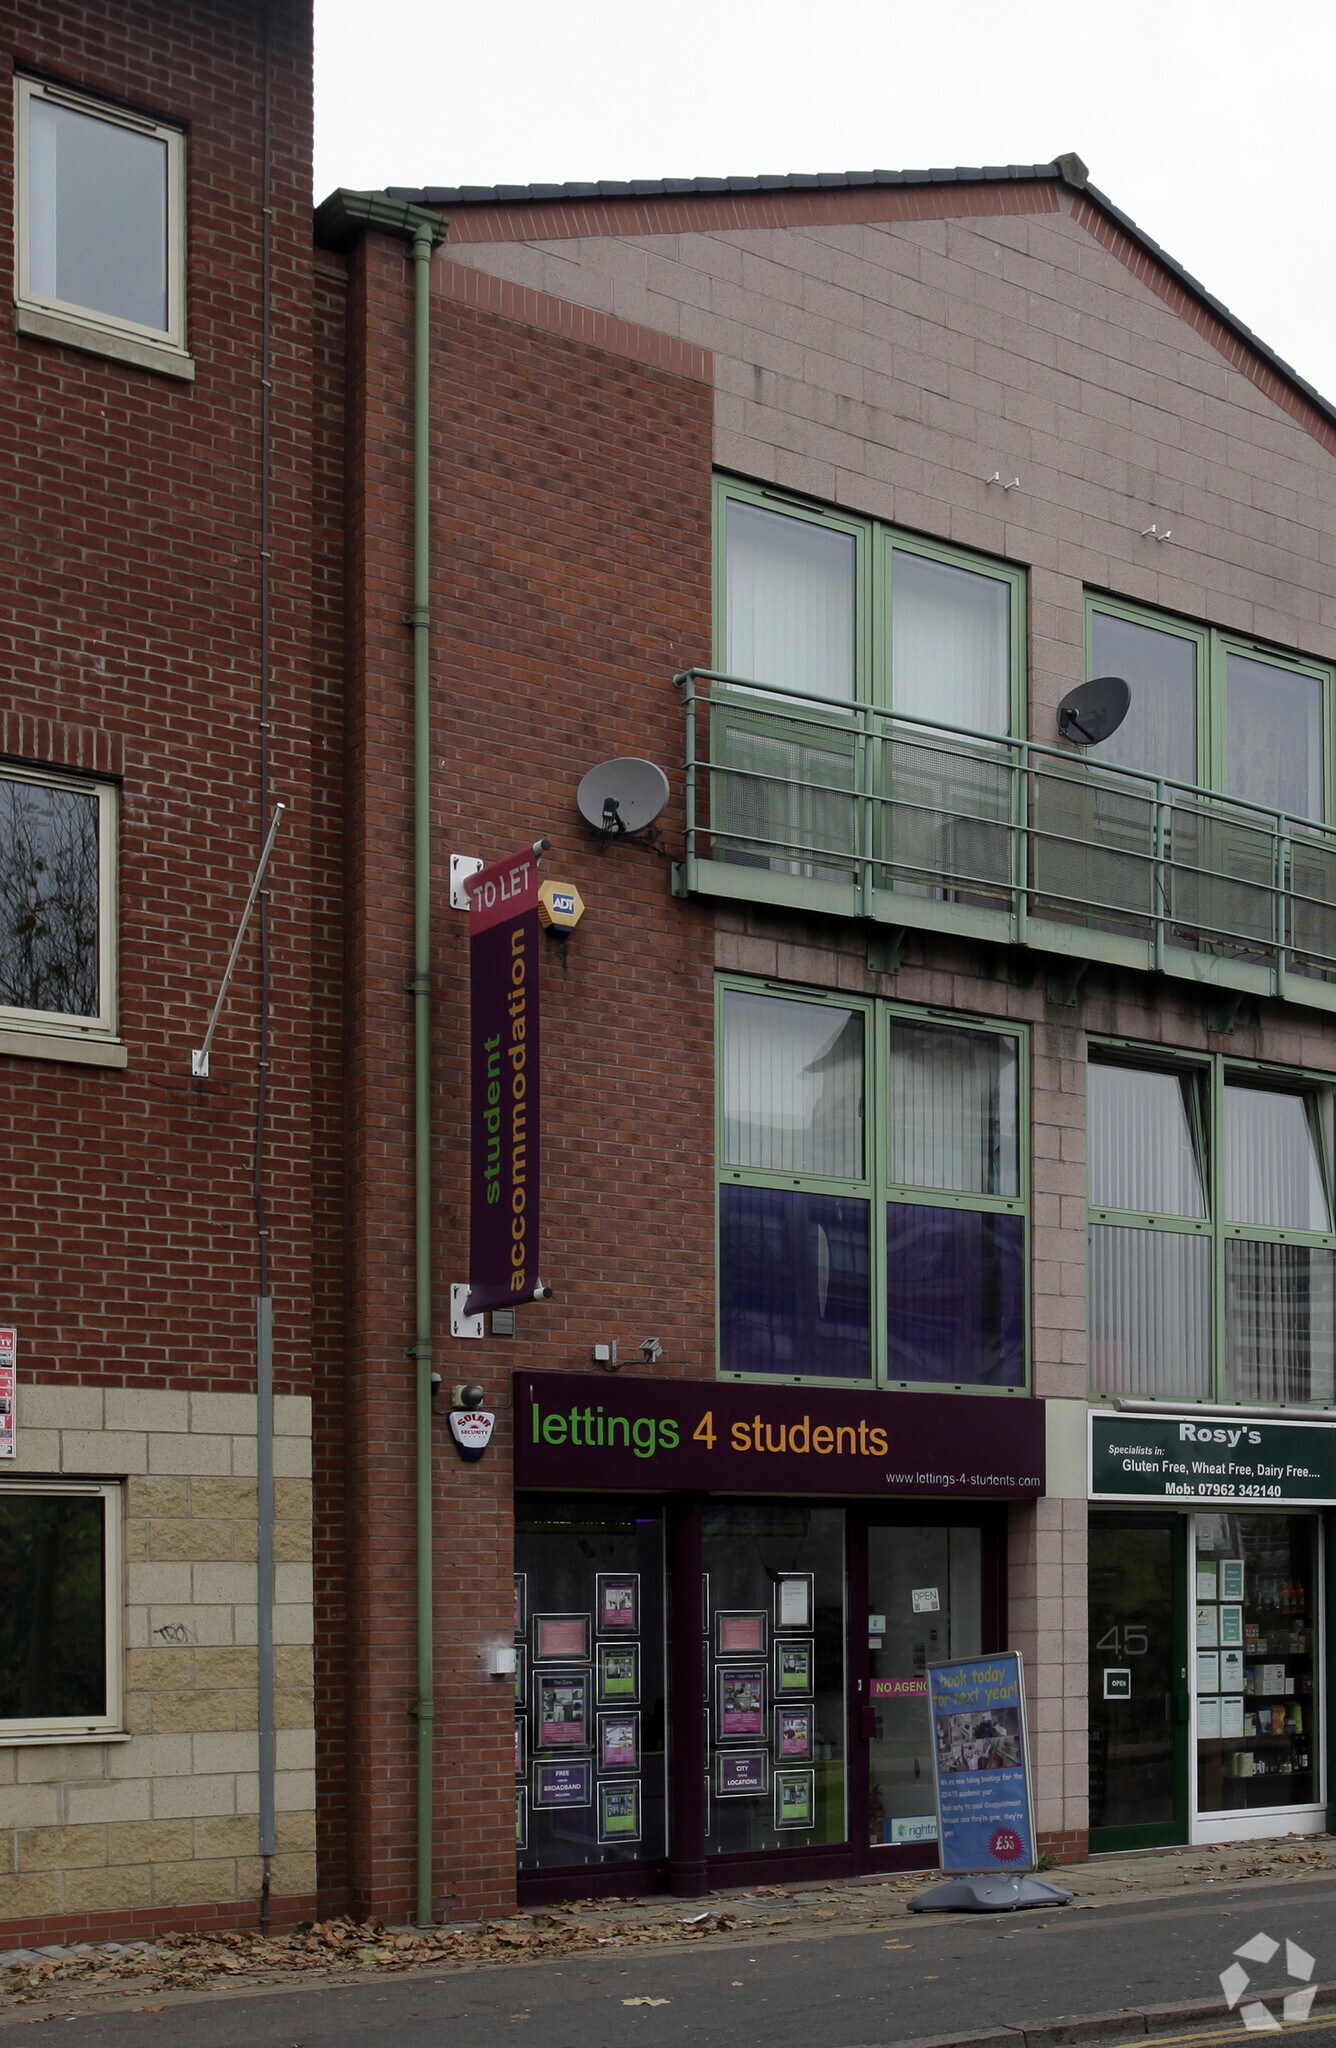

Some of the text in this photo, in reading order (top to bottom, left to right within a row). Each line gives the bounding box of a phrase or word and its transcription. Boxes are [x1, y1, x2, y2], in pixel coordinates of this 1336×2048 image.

[473, 862, 530, 912] TO LET
[553, 897, 574, 910] ADT
[484, 1033, 501, 1205] student
[508, 928, 527, 1292] accommodation
[457, 1414, 491, 1427] SOLAR
[532, 1403, 889, 1459] lettings 4 students
[1179, 1423, 1262, 1448] Rosy's
[1108, 1444, 1166, 1456] Specialists in:
[1122, 1459, 1320, 1479] Gluten Free, Wheat Free, Dairy Free....
[885, 1472, 1041, 1488] www.lettings-4-students.com
[1165, 1482, 1282, 1497] Mob: 07962 342140
[913, 1591, 937, 1601] OPEN
[1096, 1625, 1149, 1655] 45
[940, 1665, 1005, 1688] book today
[876, 1682, 891, 1692] NO
[954, 1687, 980, 1704] next
[985, 1681, 1019, 1706] year!
[1002, 1773, 1012, 1782] for
[544, 1784, 581, 1792] BROADBAND
